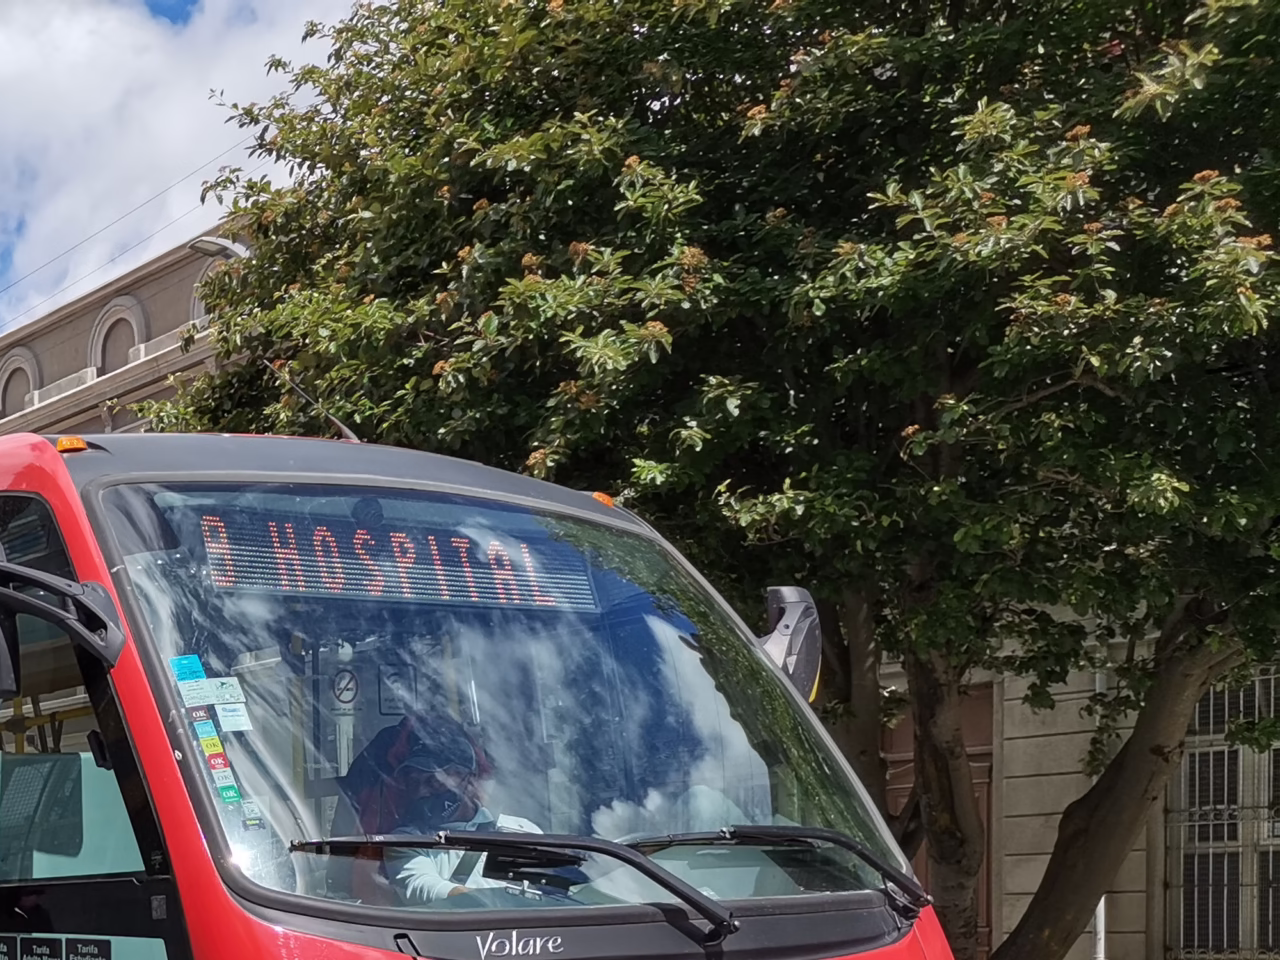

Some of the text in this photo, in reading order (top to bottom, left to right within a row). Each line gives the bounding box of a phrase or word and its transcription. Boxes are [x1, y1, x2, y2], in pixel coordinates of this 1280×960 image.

[268, 522, 556, 605] HOSPITAL
[192, 709, 208, 719] OK
[205, 742, 220, 750] OK
[210, 757, 225, 766] OK
[223, 790, 238, 798] OK
[32, 945, 50, 955] Tarifa
[77, 944, 98, 954] Tarifa
[476, 930, 564, 960] Volare
